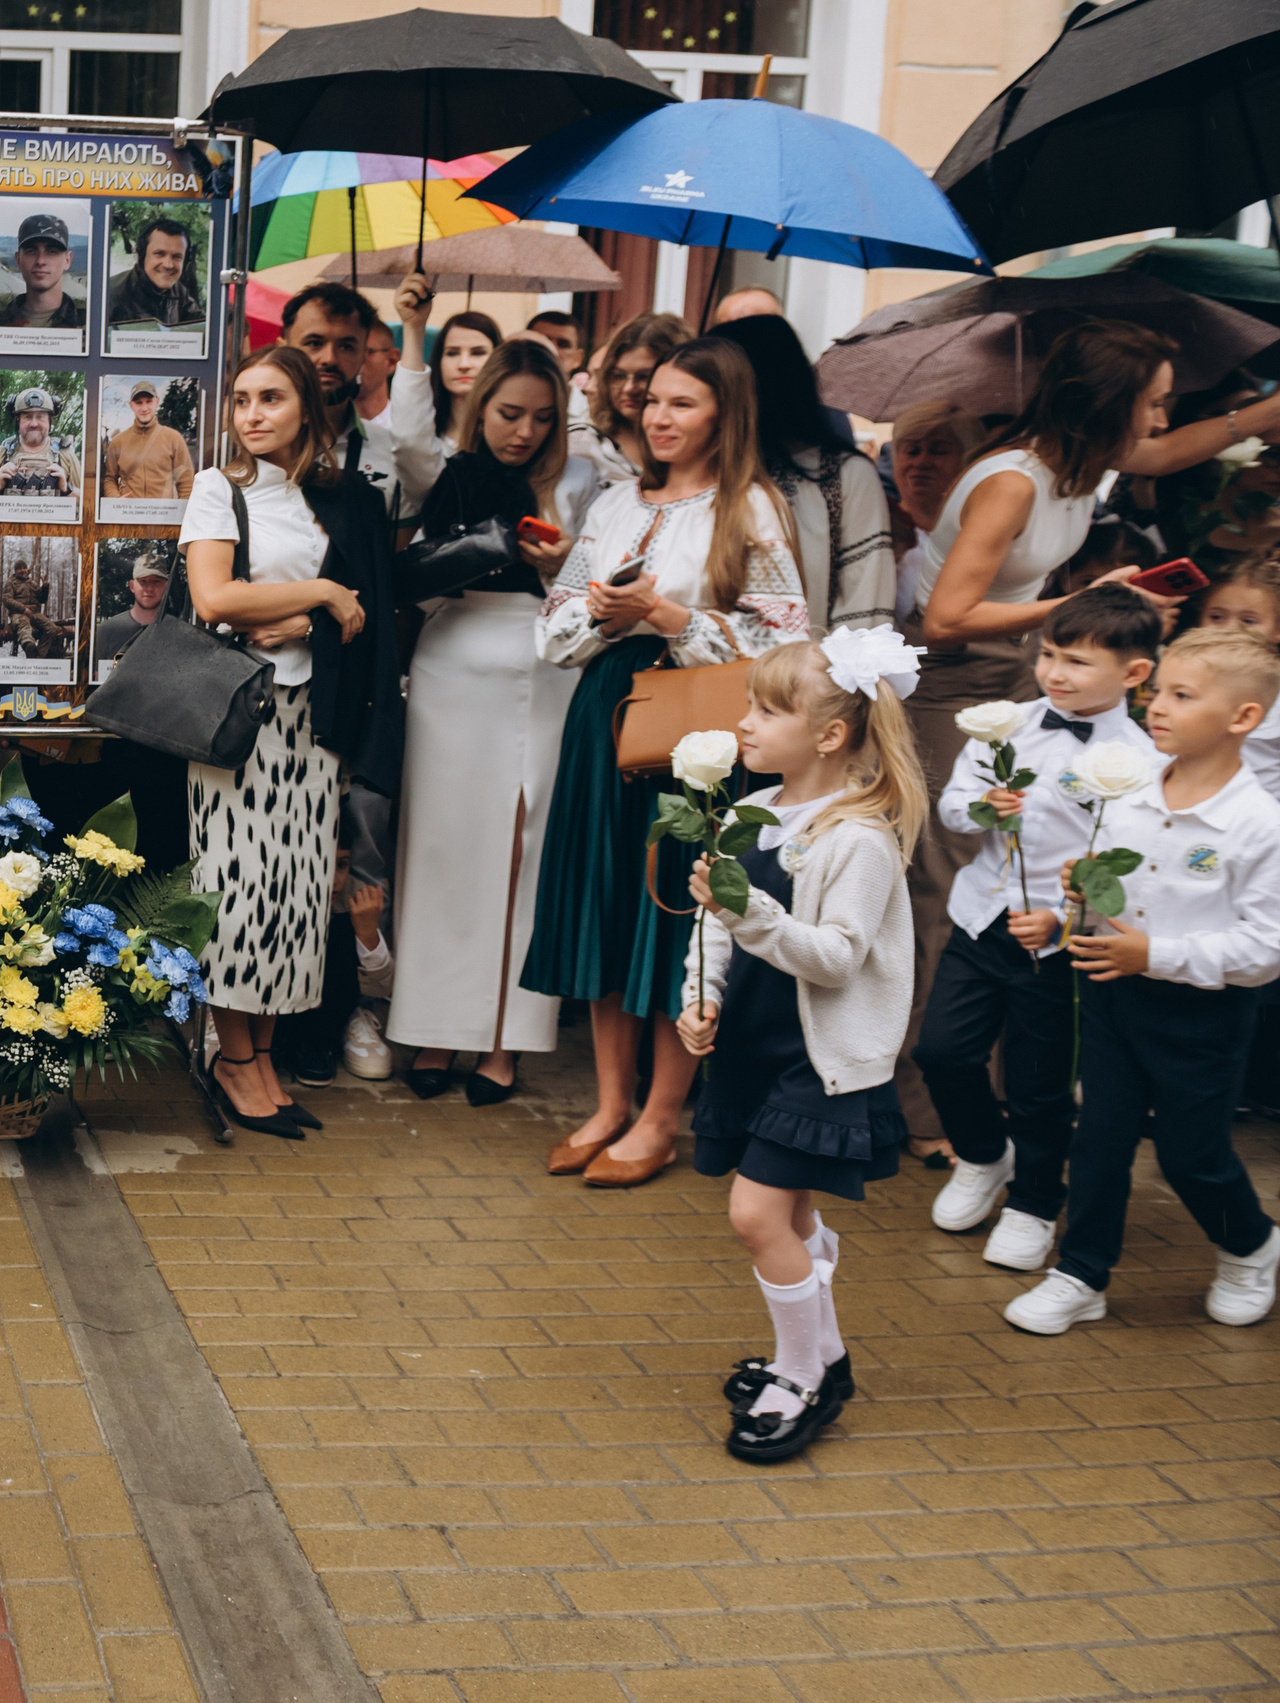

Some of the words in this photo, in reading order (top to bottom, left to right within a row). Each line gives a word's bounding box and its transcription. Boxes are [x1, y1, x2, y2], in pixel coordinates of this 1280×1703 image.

[24, 140, 173, 169] ВМИРАЮТЬ,
[42, 168, 84, 188] ПРО
[90, 170, 132, 190] НИХ
[137, 171, 199, 192] ЖИВА
